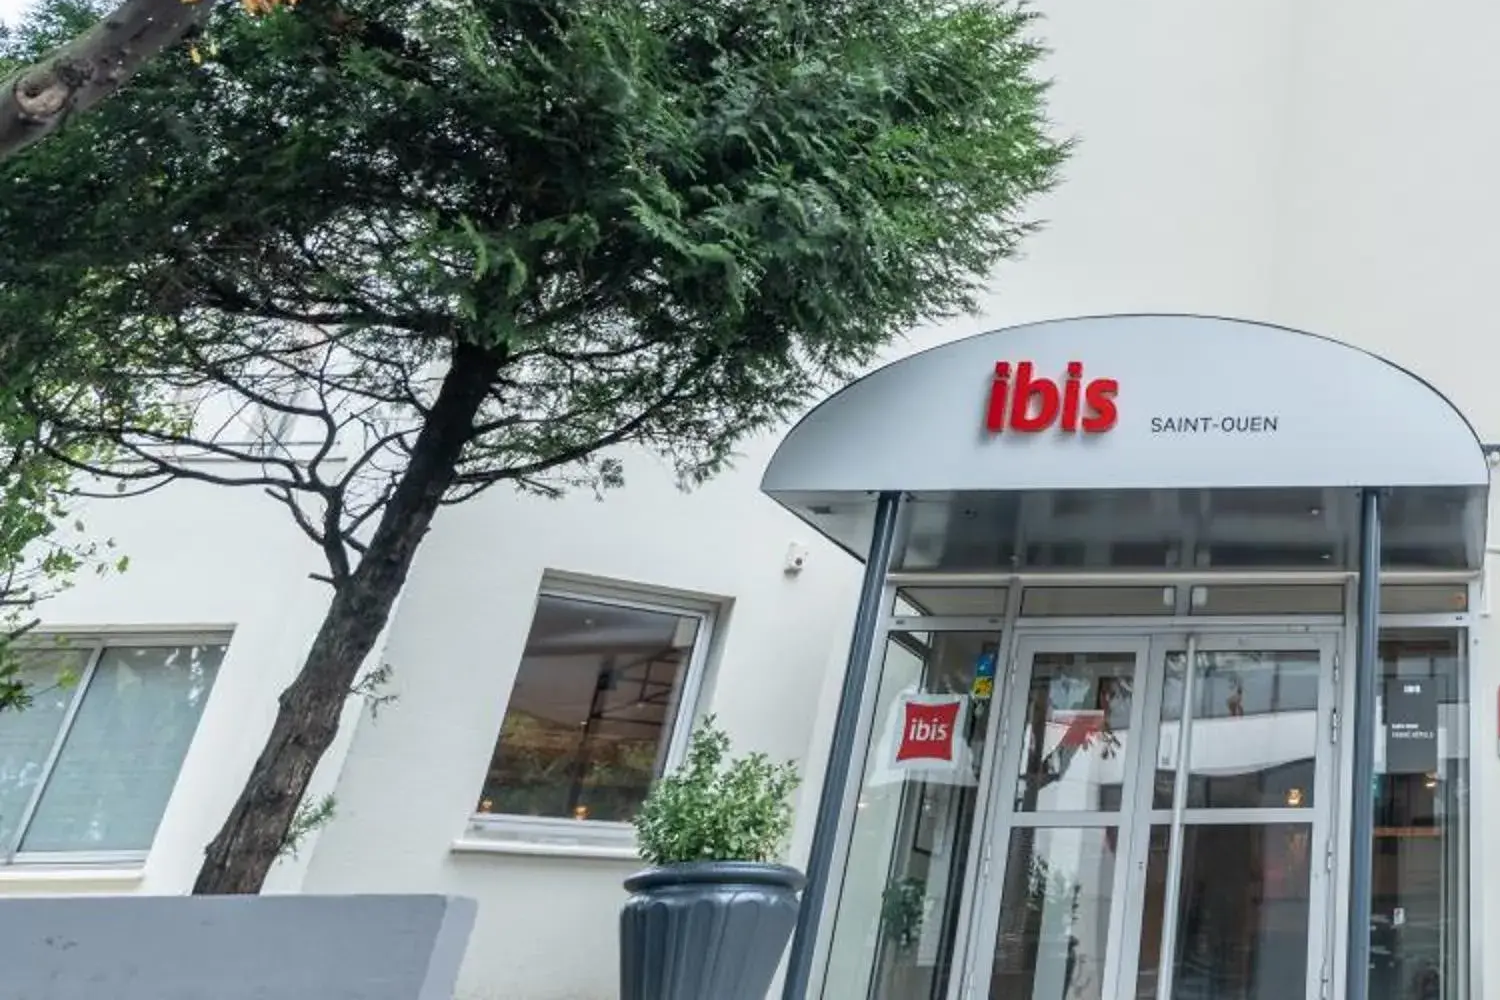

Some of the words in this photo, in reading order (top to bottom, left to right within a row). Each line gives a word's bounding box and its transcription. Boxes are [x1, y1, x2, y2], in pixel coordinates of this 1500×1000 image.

[987, 361, 1119, 432] ibis
[1151, 416, 1278, 433] SAINT-OUEN
[909, 717, 950, 741] ibis
